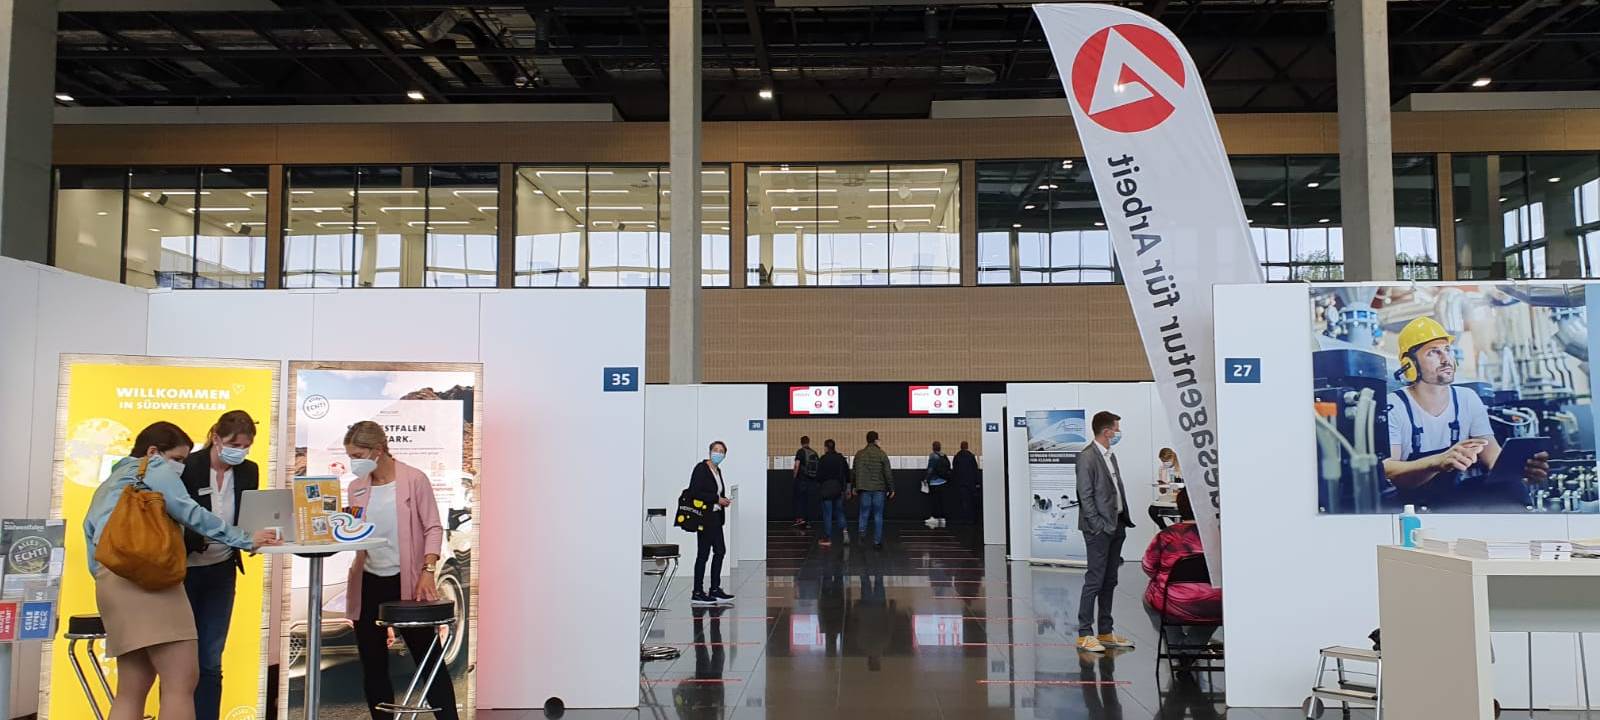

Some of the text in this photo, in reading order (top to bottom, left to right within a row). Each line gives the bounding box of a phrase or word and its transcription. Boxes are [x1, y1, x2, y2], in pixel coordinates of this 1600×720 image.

[1233, 364, 1252, 377] 27
[611, 373, 631, 386] 35
[116, 387, 230, 400] WILLKOMMEN
[119, 399, 226, 410] IN SÜDWESTFALEN
[14, 546, 48, 563] ECHT!
